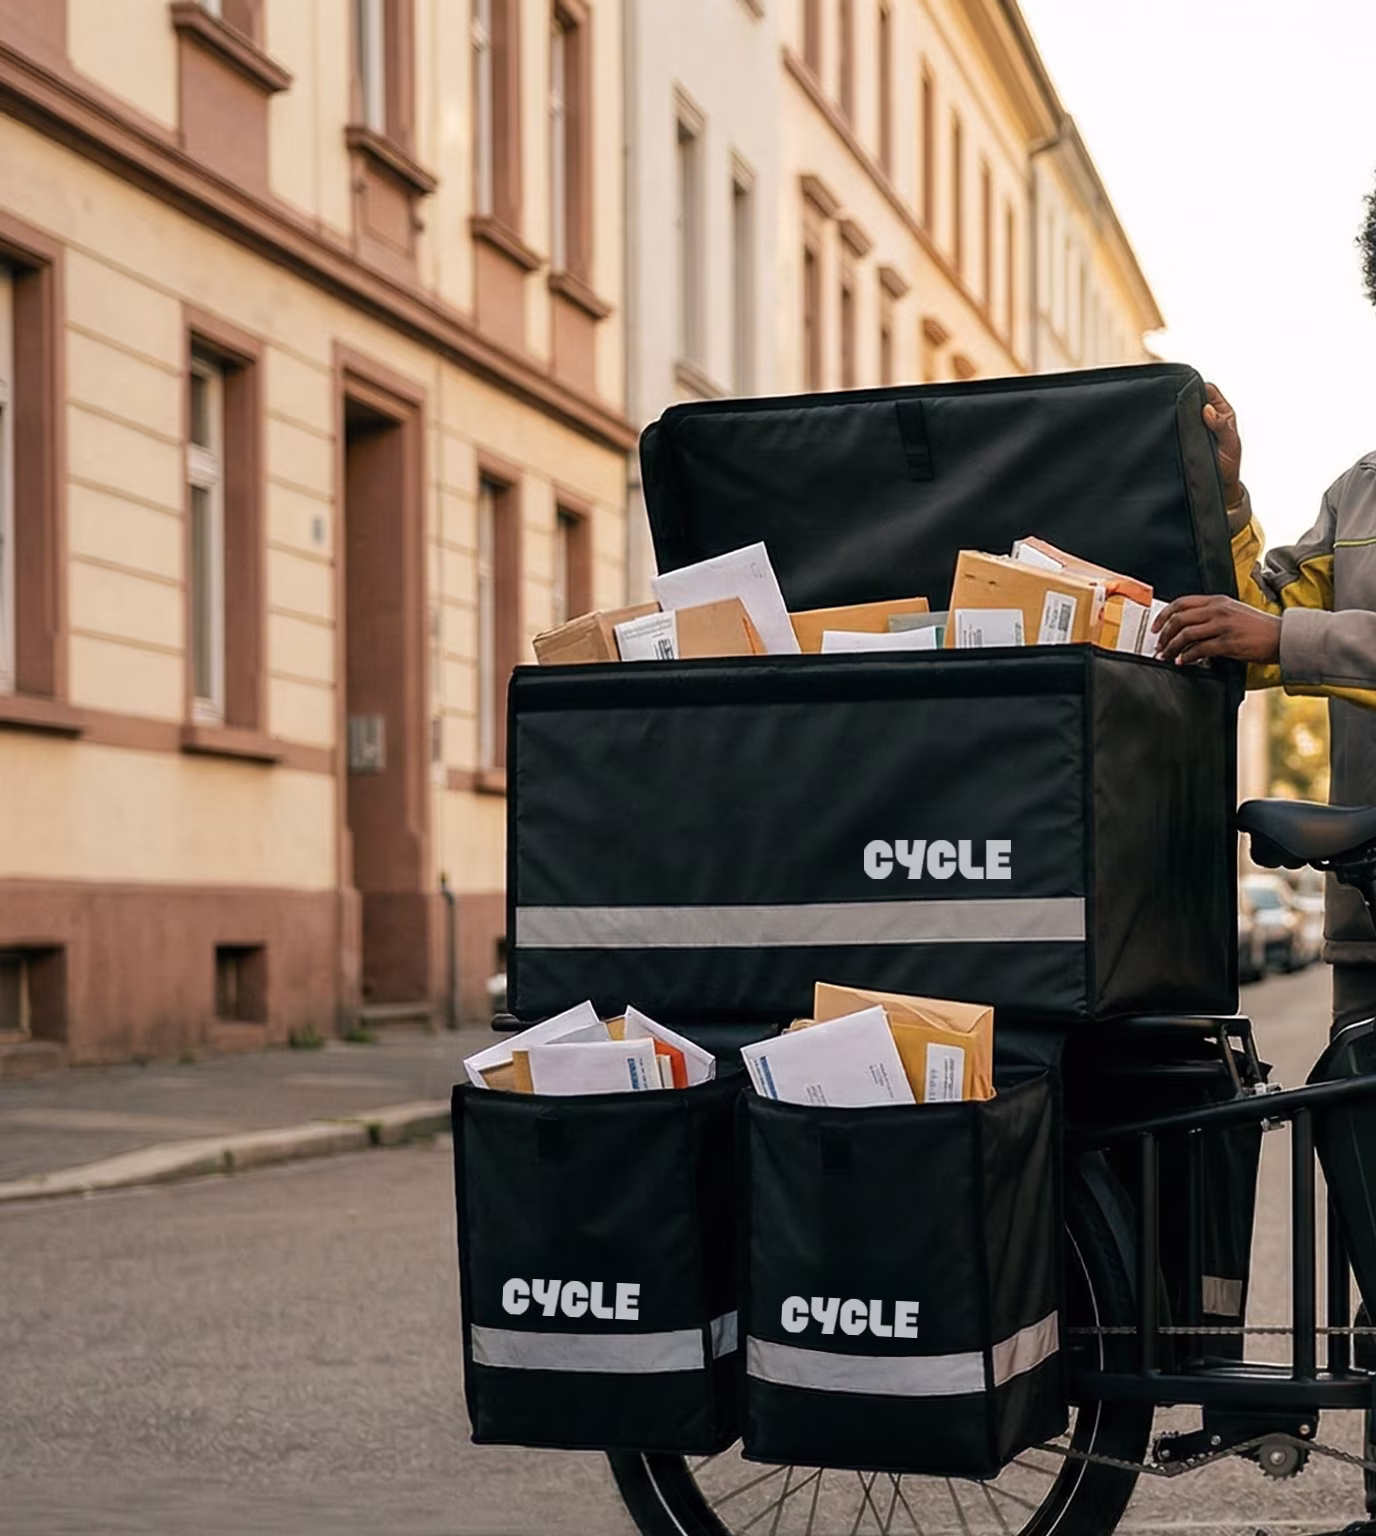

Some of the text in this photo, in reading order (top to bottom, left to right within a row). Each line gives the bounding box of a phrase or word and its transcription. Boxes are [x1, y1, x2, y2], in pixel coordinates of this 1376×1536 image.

[864, 840, 1011, 879] CYCLE
[502, 1278, 640, 1320] CYCLE
[781, 1296, 919, 1338] CYCLE
